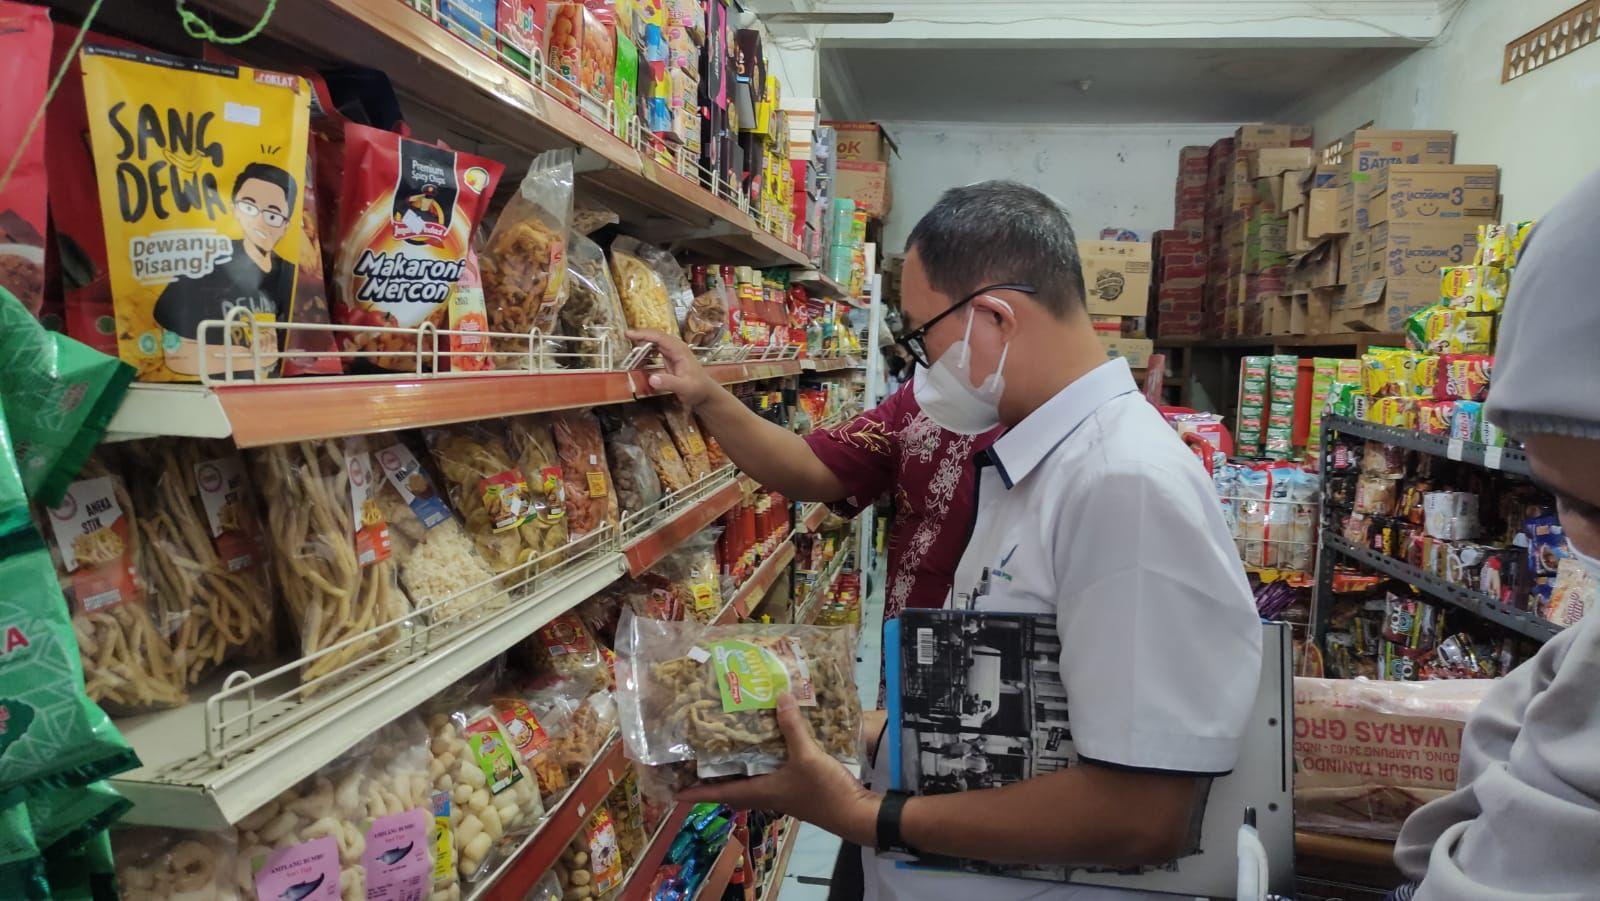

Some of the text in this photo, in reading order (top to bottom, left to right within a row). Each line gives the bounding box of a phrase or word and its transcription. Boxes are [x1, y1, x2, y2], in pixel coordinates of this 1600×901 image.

[108, 101, 224, 168] SANG
[412, 159, 445, 177] Premium
[116, 160, 227, 224] DEWA
[1451, 187, 1464, 206] 3
[133, 236, 230, 258] Dewanya
[1450, 243, 1463, 262] 3
[135, 250, 213, 277] Pisang!
[355, 251, 466, 282] Makaroni
[358, 277, 450, 303] Mercon
[86, 496, 114, 517] ANEKA
[81, 517, 104, 536] STIK
[1355, 720, 1449, 748] WARAS
[1364, 746, 1420, 761] LAMPUNG
[1302, 756, 1373, 776] TANINDO
[1377, 762, 1434, 781] SUBUR
